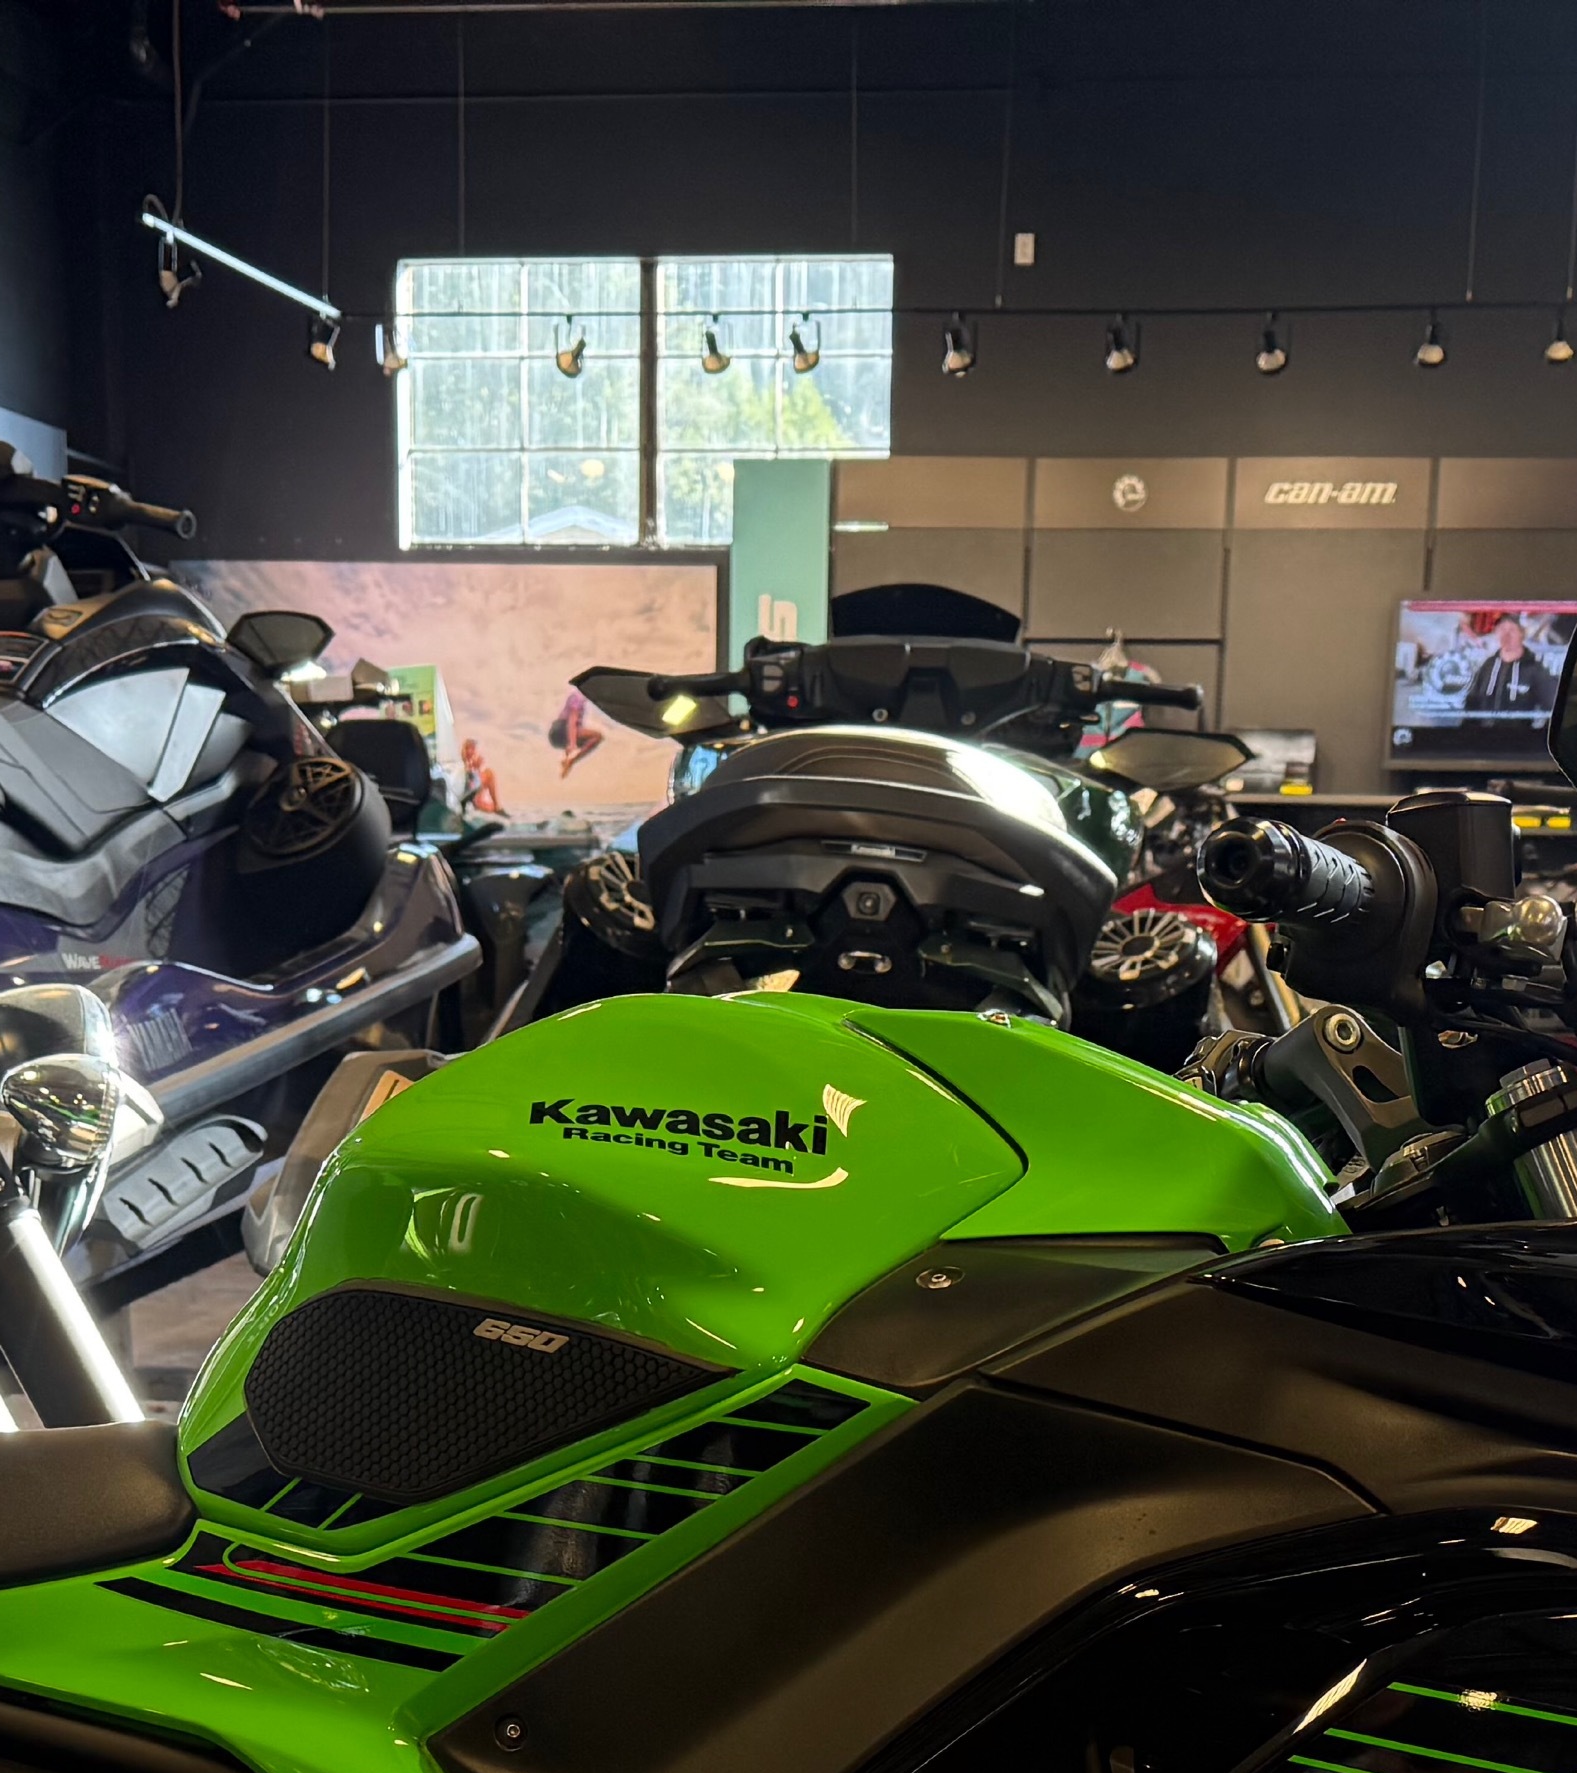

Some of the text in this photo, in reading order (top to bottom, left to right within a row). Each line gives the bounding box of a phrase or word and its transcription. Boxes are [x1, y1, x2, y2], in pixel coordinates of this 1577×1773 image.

[1264, 481, 1397, 505] can-am
[529, 1098, 829, 1156] Kawasaki
[562, 1127, 794, 1175] Racing Team
[472, 1318, 570, 1354] 650
